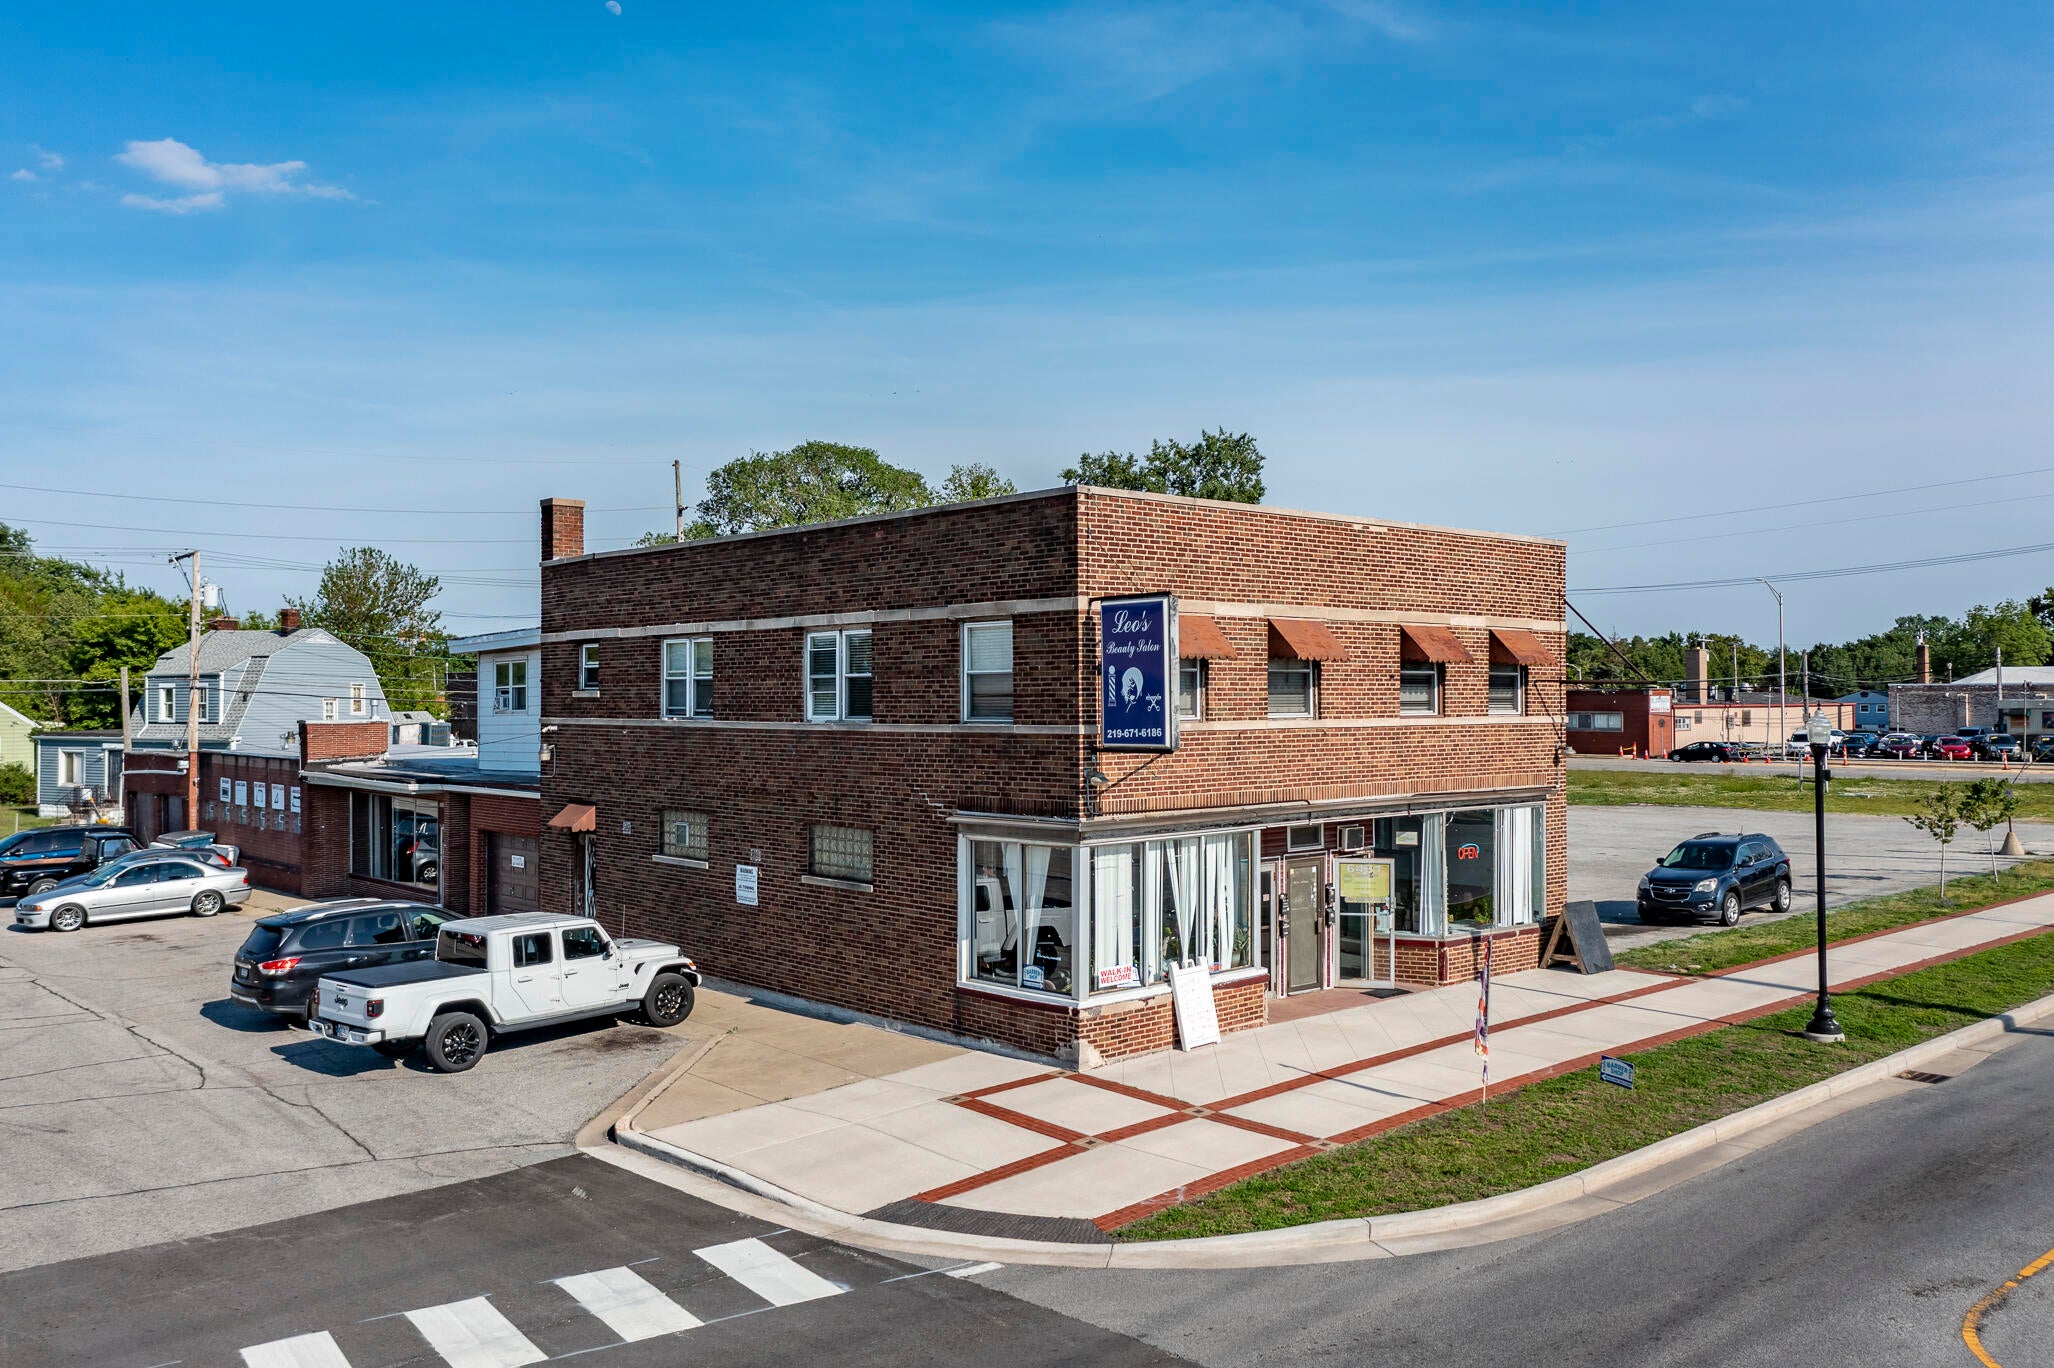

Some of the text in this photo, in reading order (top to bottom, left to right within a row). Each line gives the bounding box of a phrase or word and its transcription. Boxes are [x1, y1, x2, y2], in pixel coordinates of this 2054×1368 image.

[1112, 610, 1152, 634] Leo's
[1106, 638, 1161, 658] Beauty Salon
[1107, 728, 1162, 738] 219-671-6186
[1457, 847, 1479, 860] OPEN
[1100, 966, 1132, 977] WALK-IN
[1100, 973, 1132, 985] WELCOME
